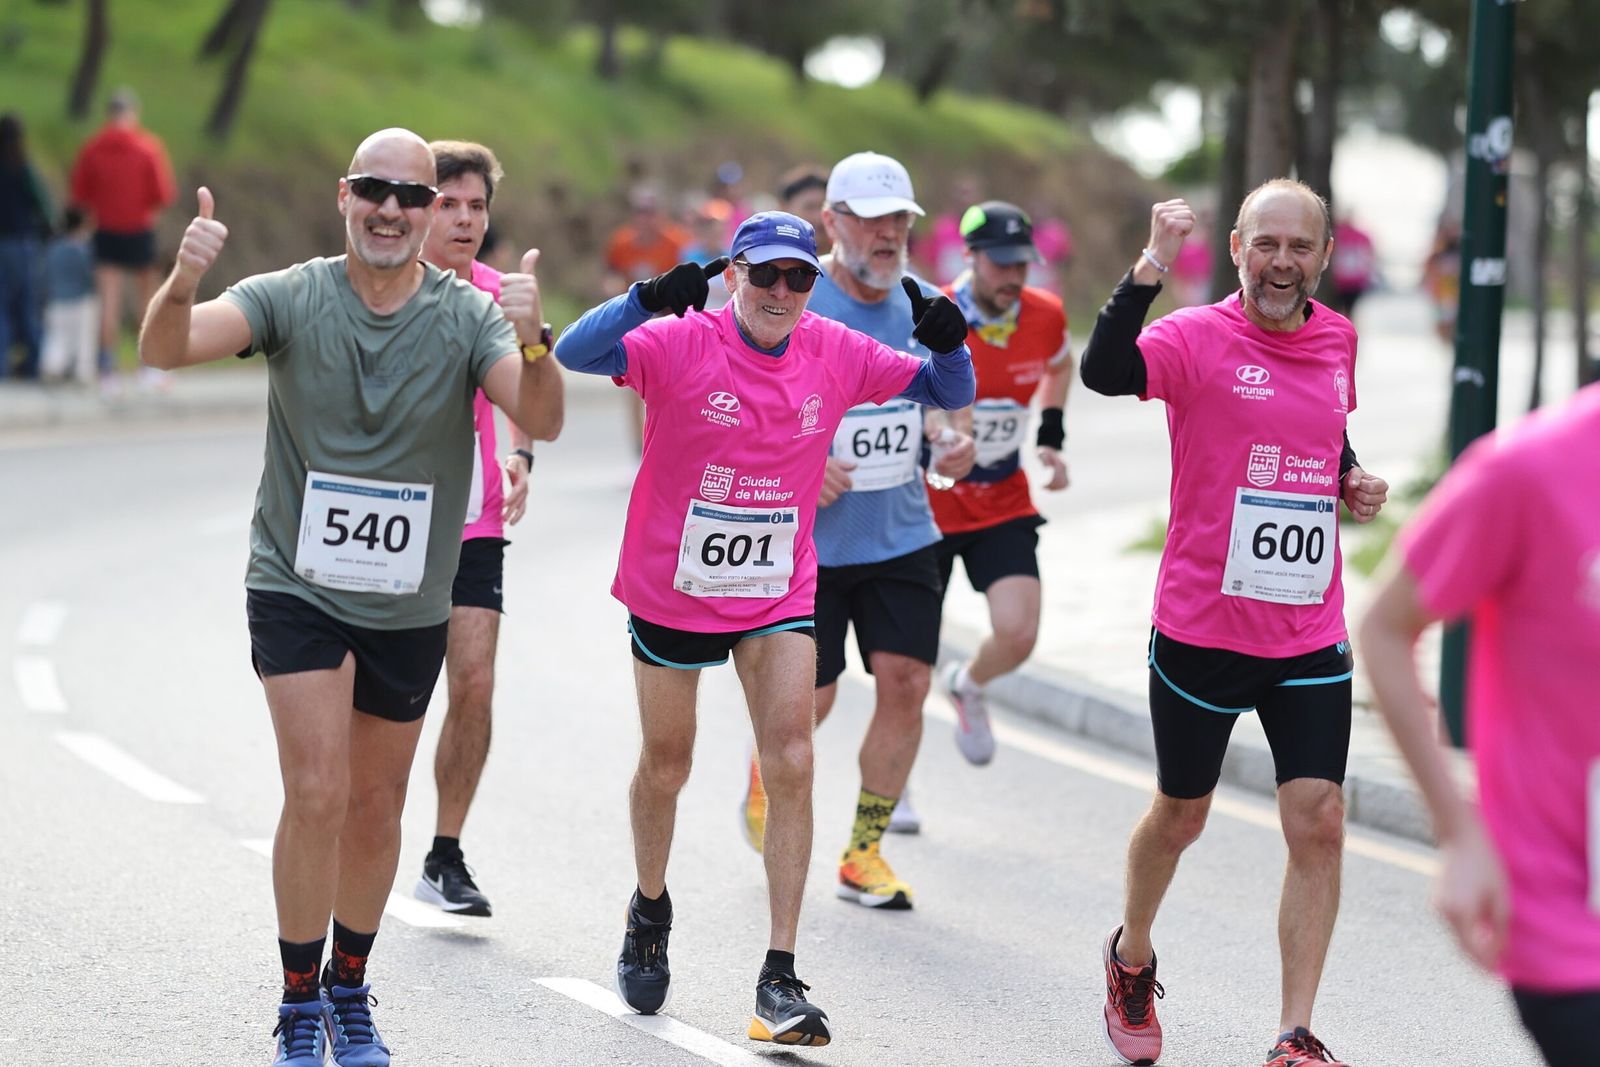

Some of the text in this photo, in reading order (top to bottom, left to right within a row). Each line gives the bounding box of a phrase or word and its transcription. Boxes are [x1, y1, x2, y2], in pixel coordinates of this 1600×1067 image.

[1233, 385, 1275, 397] HYUNDAI
[700, 408, 741, 427] HYUNDAI
[852, 424, 909, 458] 642
[1285, 455, 1326, 469] Ciudad
[738, 476, 781, 487] Ciudad
[1283, 470, 1333, 487] de Málaga
[735, 489, 794, 502] de Málaga
[323, 507, 411, 553] 540
[701, 533, 775, 567] 601
[1252, 522, 1325, 565] 600
